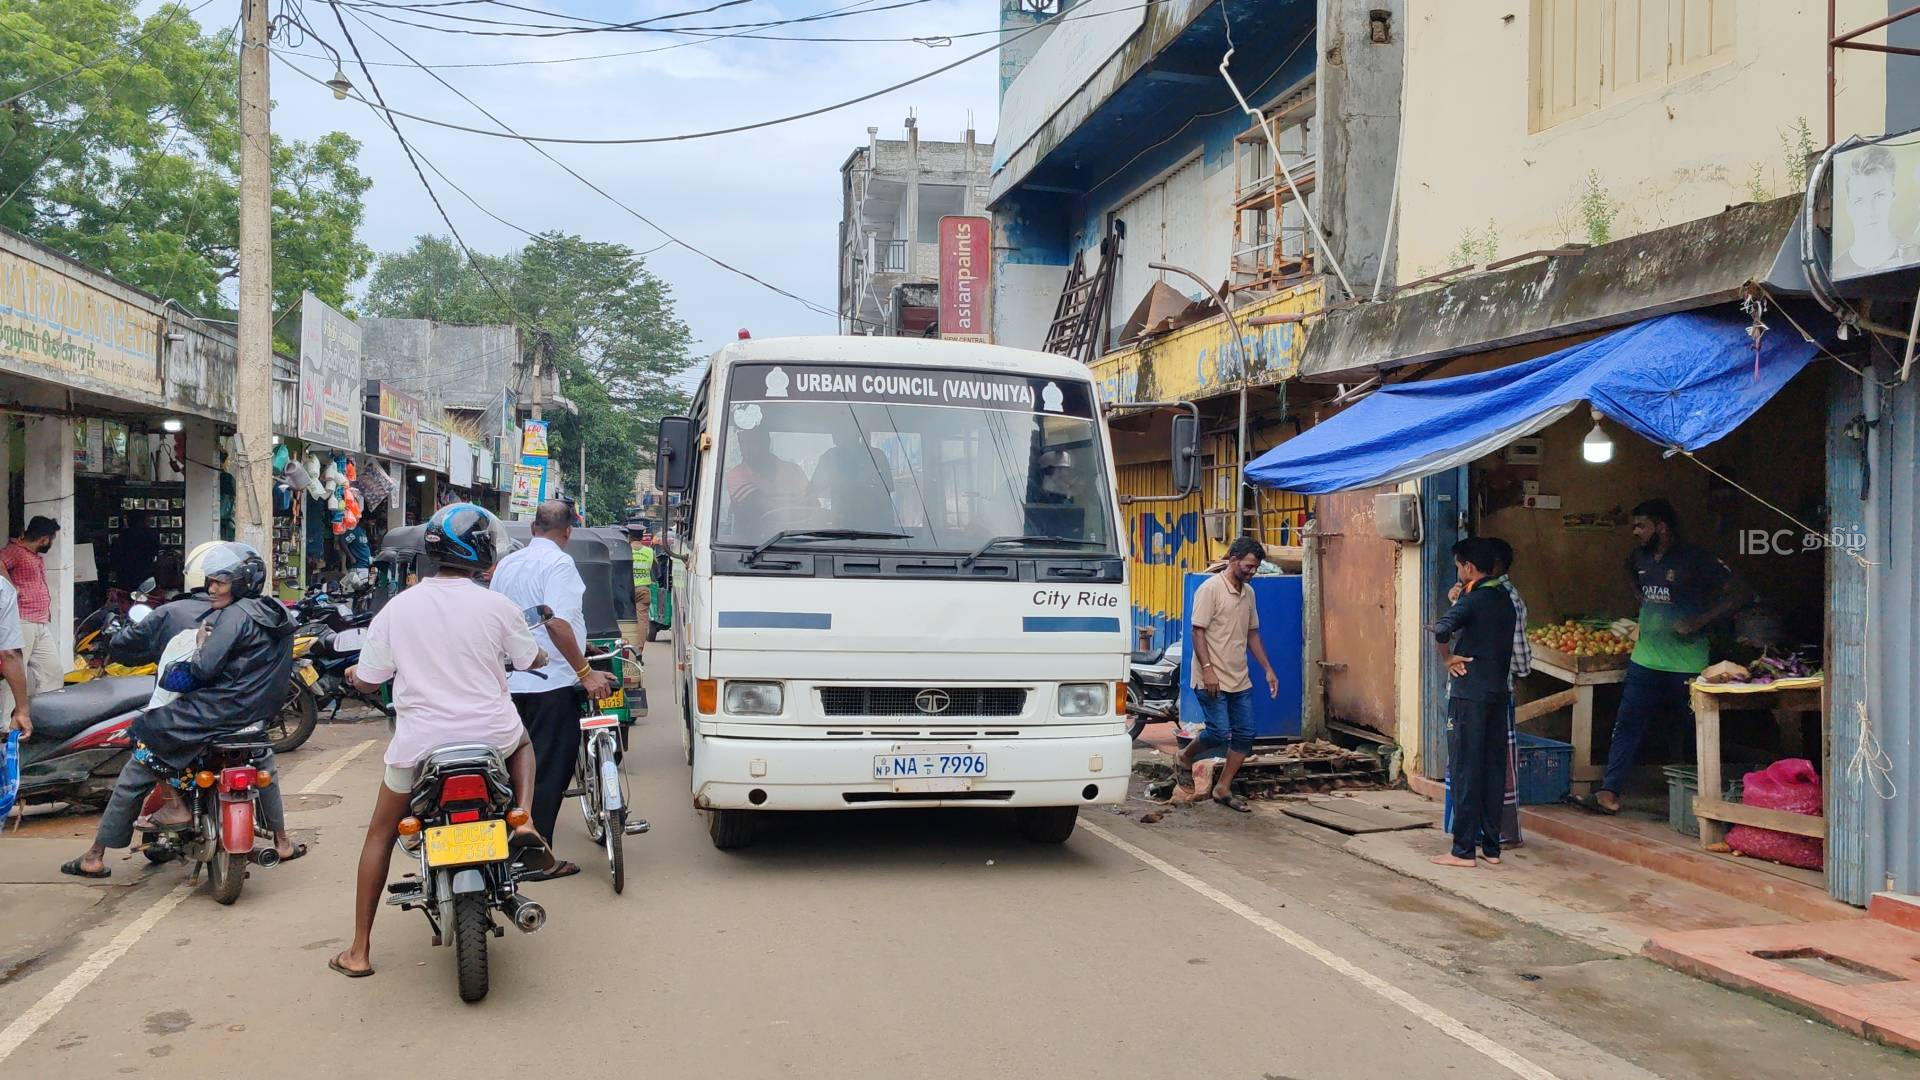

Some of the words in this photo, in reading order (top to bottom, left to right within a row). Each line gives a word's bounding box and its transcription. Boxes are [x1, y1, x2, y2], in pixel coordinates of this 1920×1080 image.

[954, 223, 979, 329] asianpaints
[796, 373, 857, 394] URBAN
[861, 375, 938, 397] COUNCIL
[942, 379, 1035, 406] (VAVUNIYA)
[1032, 590, 1071, 610] City
[1077, 592, 1118, 608] Ride
[1642, 585, 1670, 596] QATAR
[894, 757, 917, 775] NA
[940, 756, 985, 774] 7996
